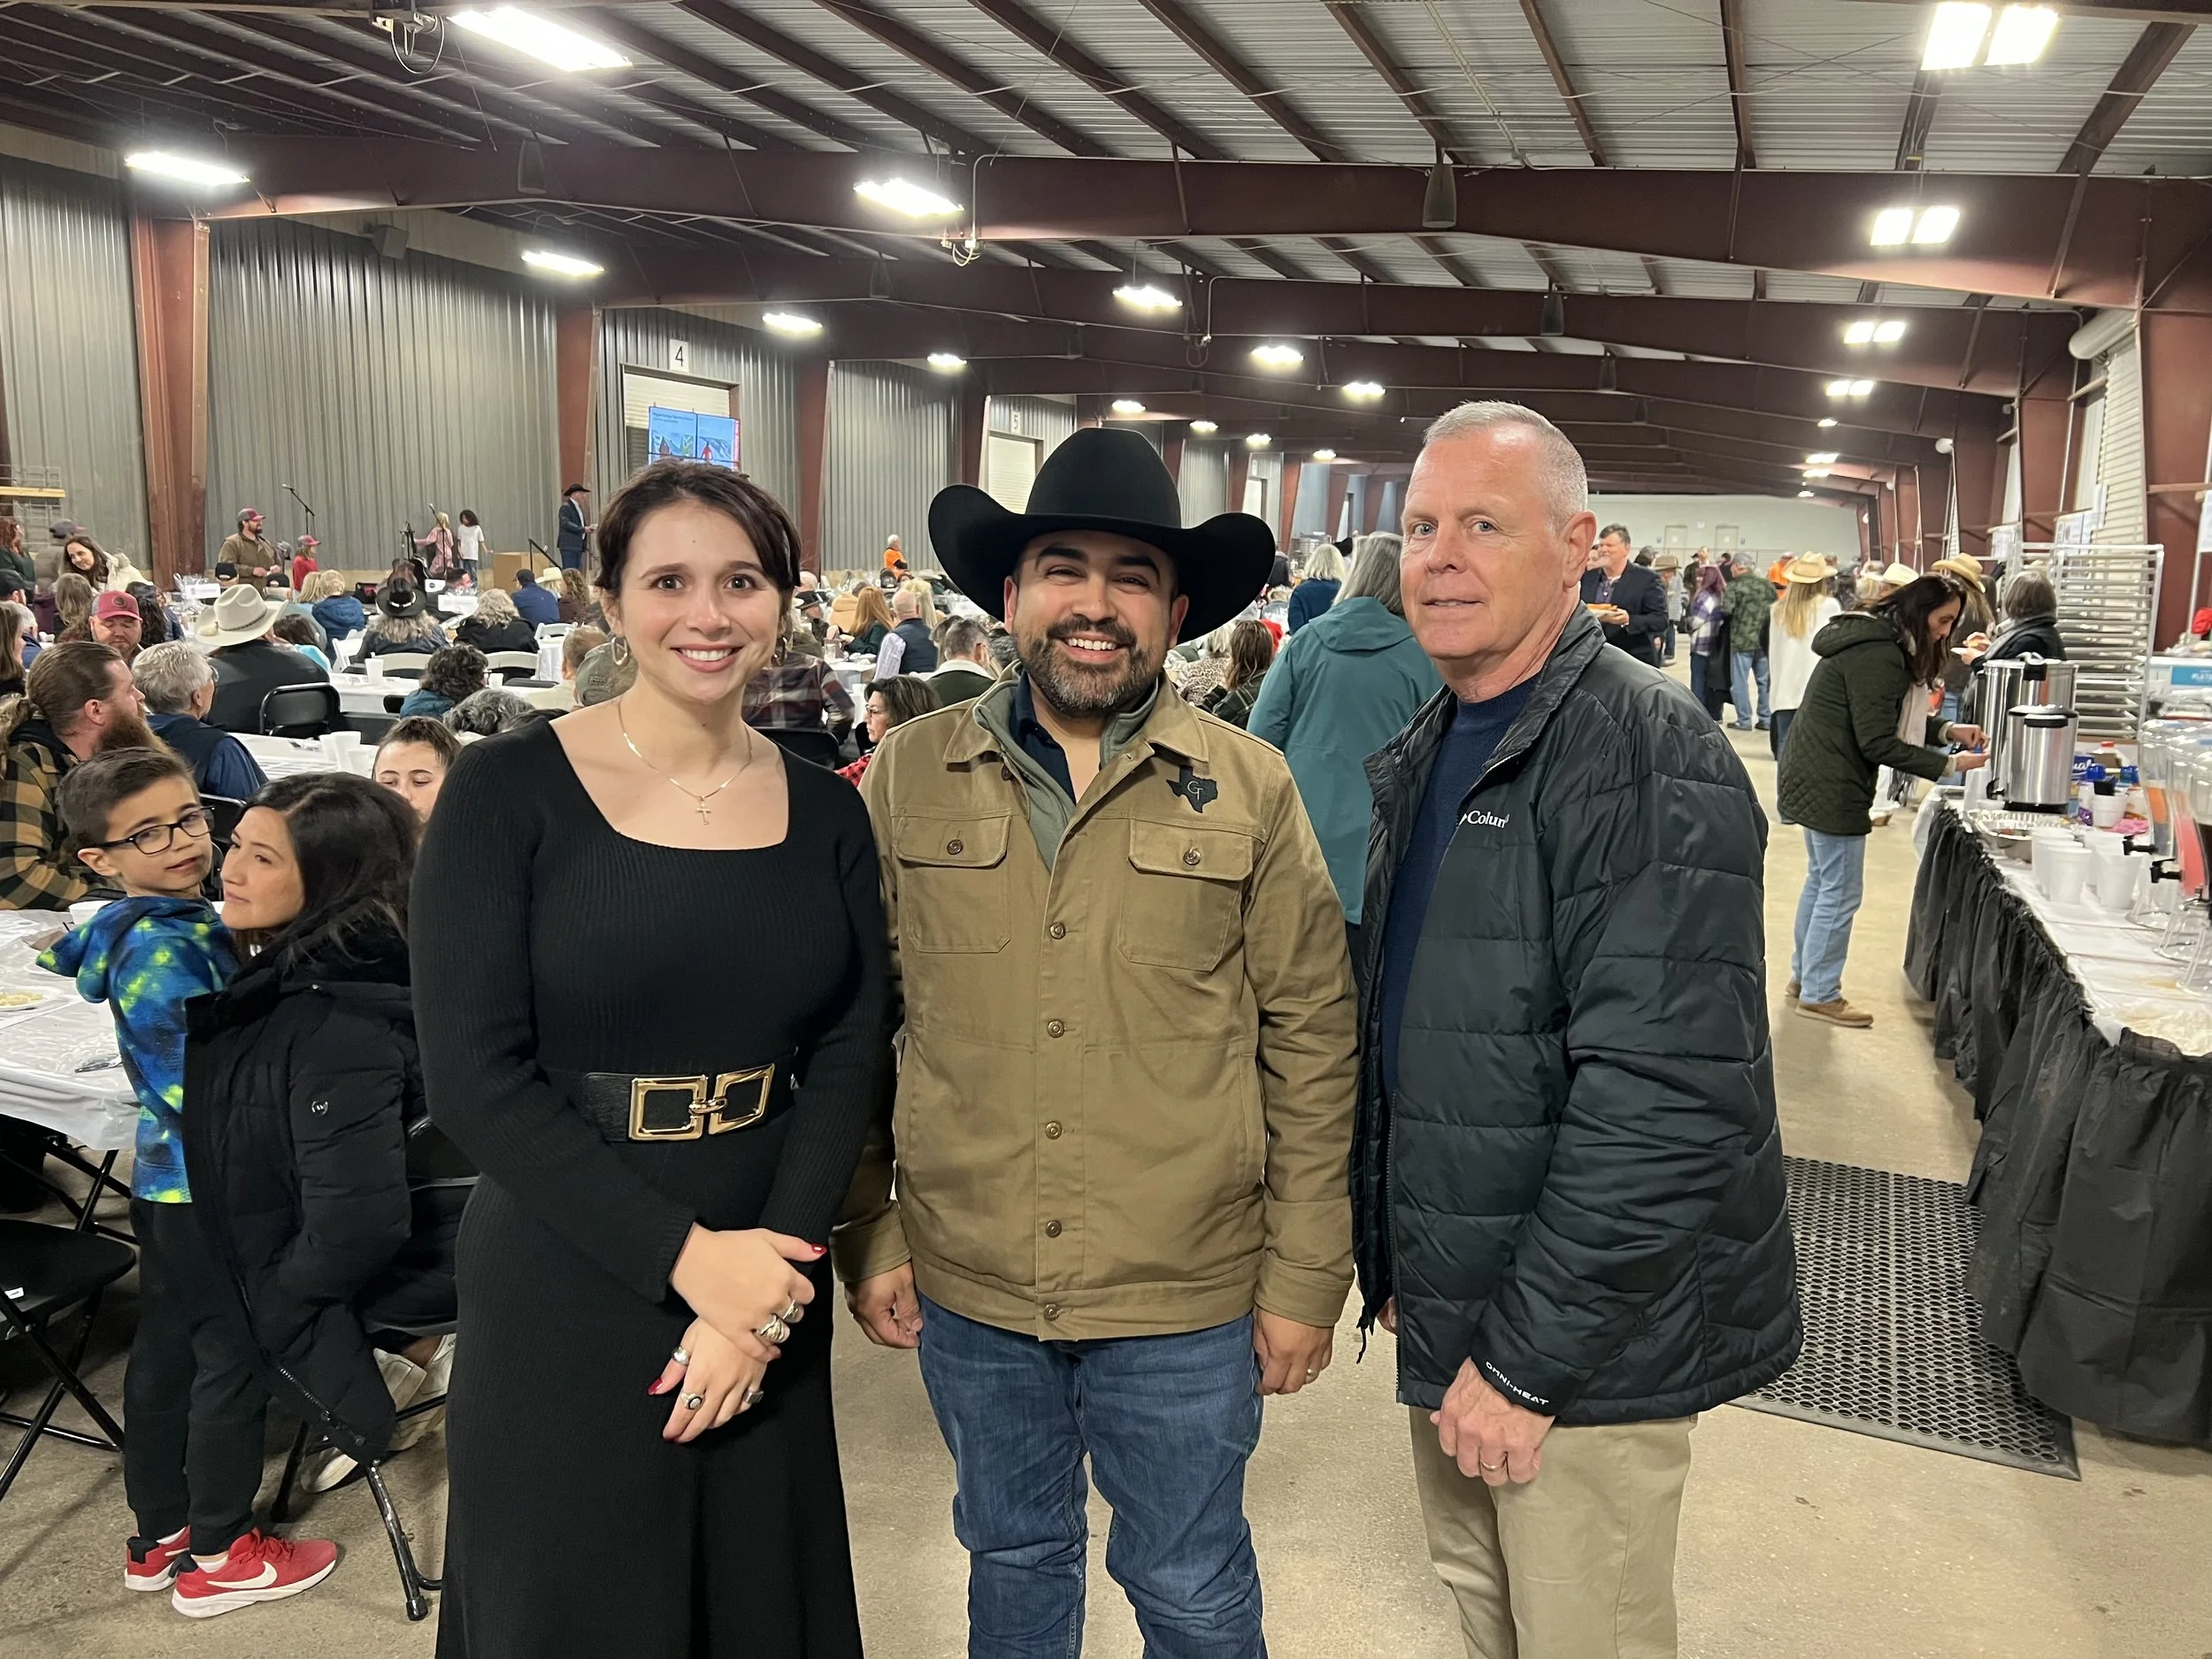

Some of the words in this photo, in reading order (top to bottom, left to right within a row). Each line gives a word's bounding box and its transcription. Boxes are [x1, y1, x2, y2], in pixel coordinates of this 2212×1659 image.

[675, 345, 684, 367] 4
[2072, 758, 2092, 771] ual
[1486, 1361, 1549, 1405] OMNI-HEAT
